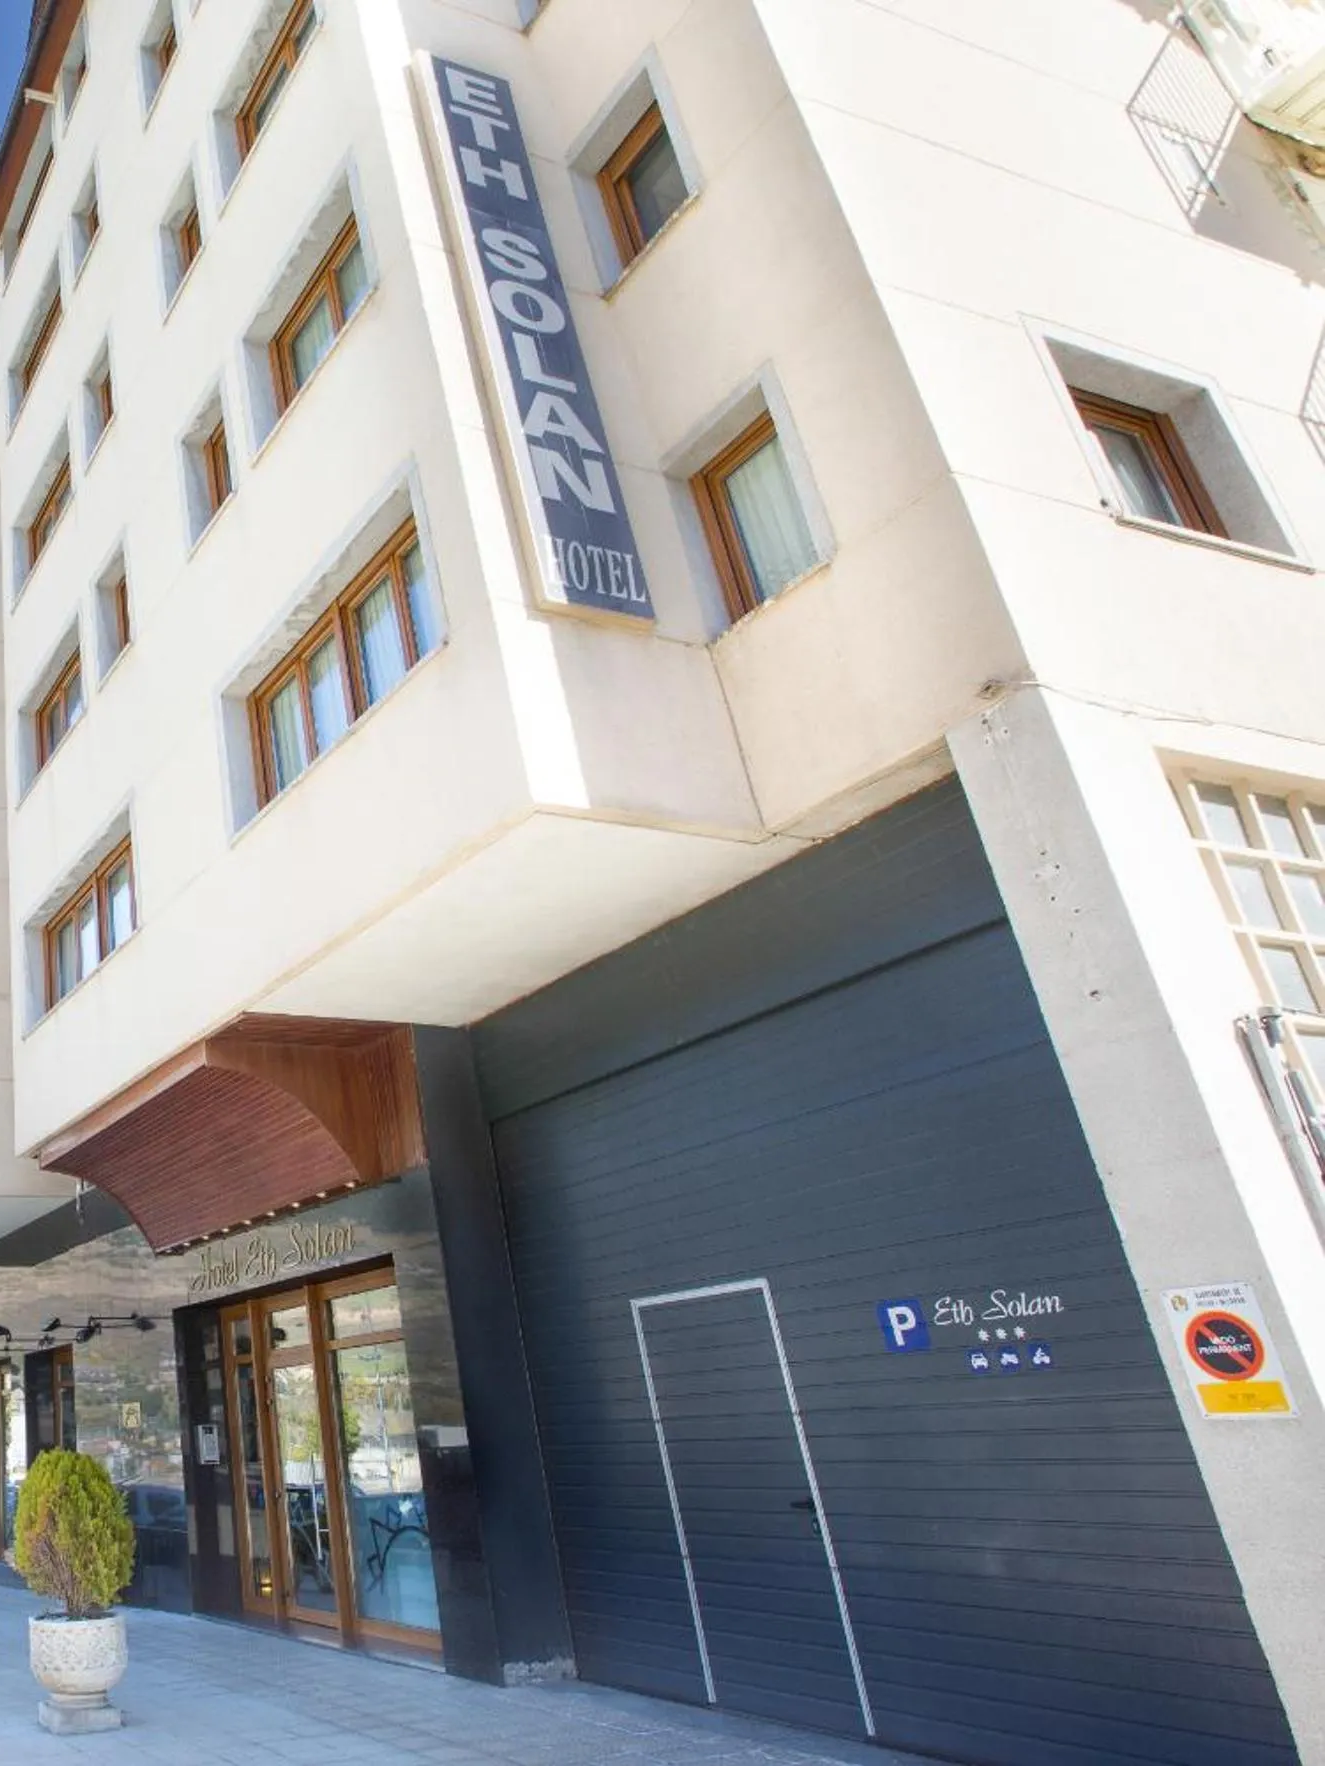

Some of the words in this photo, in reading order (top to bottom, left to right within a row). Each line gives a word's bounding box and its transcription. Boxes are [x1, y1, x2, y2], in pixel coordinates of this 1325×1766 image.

[445, 66, 527, 200] ETH
[482, 228, 616, 514] SOLAN
[544, 536, 646, 602] HOTEL
[190, 1245, 239, 1291] Hotel
[283, 1220, 356, 1268] Solan
[887, 1306, 917, 1346] P
[981, 1289, 1065, 1321] Solan
